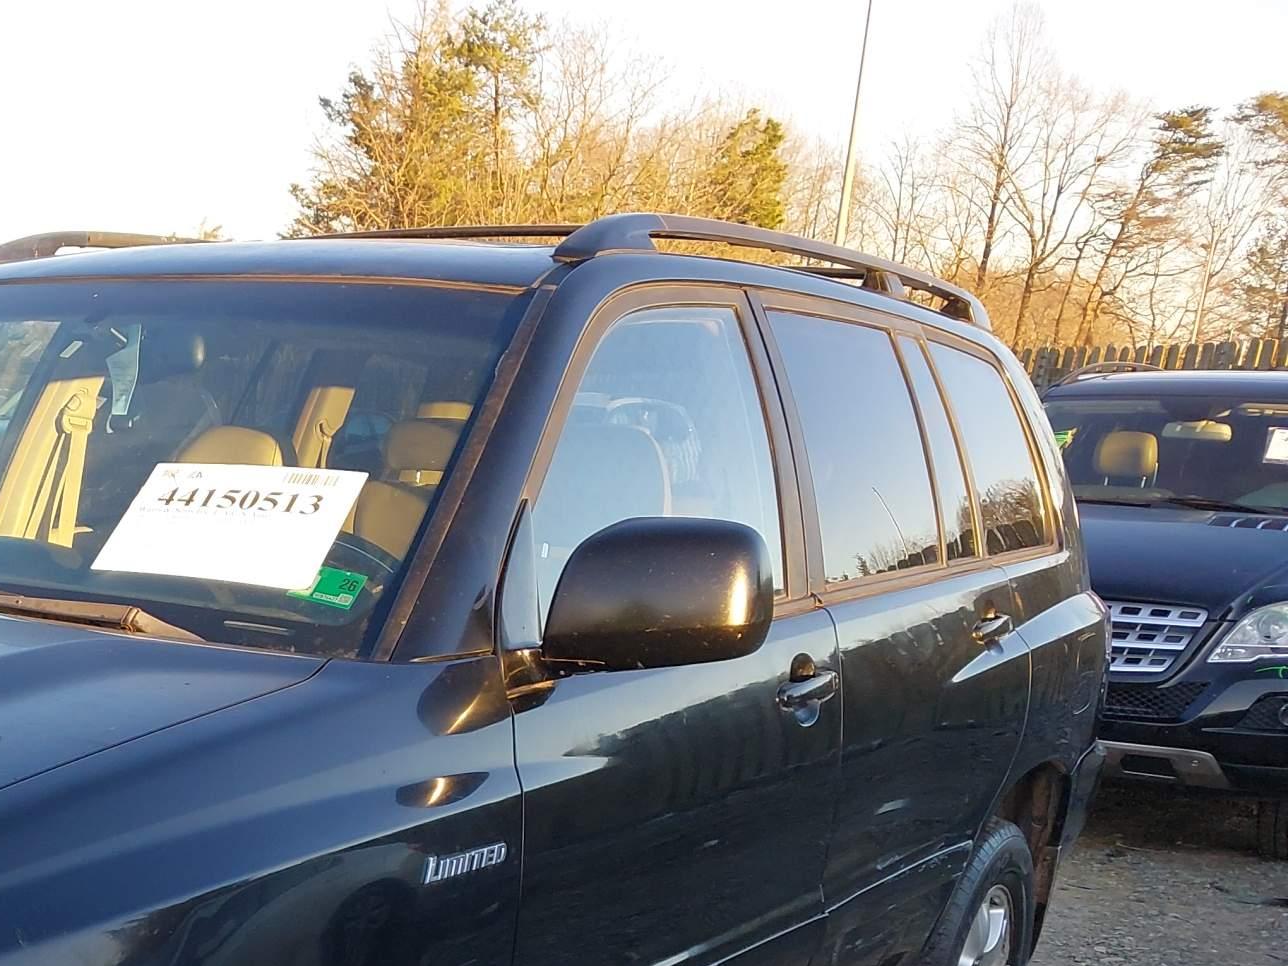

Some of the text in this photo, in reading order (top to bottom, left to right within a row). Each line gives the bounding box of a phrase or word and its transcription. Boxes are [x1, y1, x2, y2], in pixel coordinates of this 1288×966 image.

[157, 487, 324, 515] 44150513
[339, 578, 360, 592] 26
[423, 842, 507, 885] LIMITED
